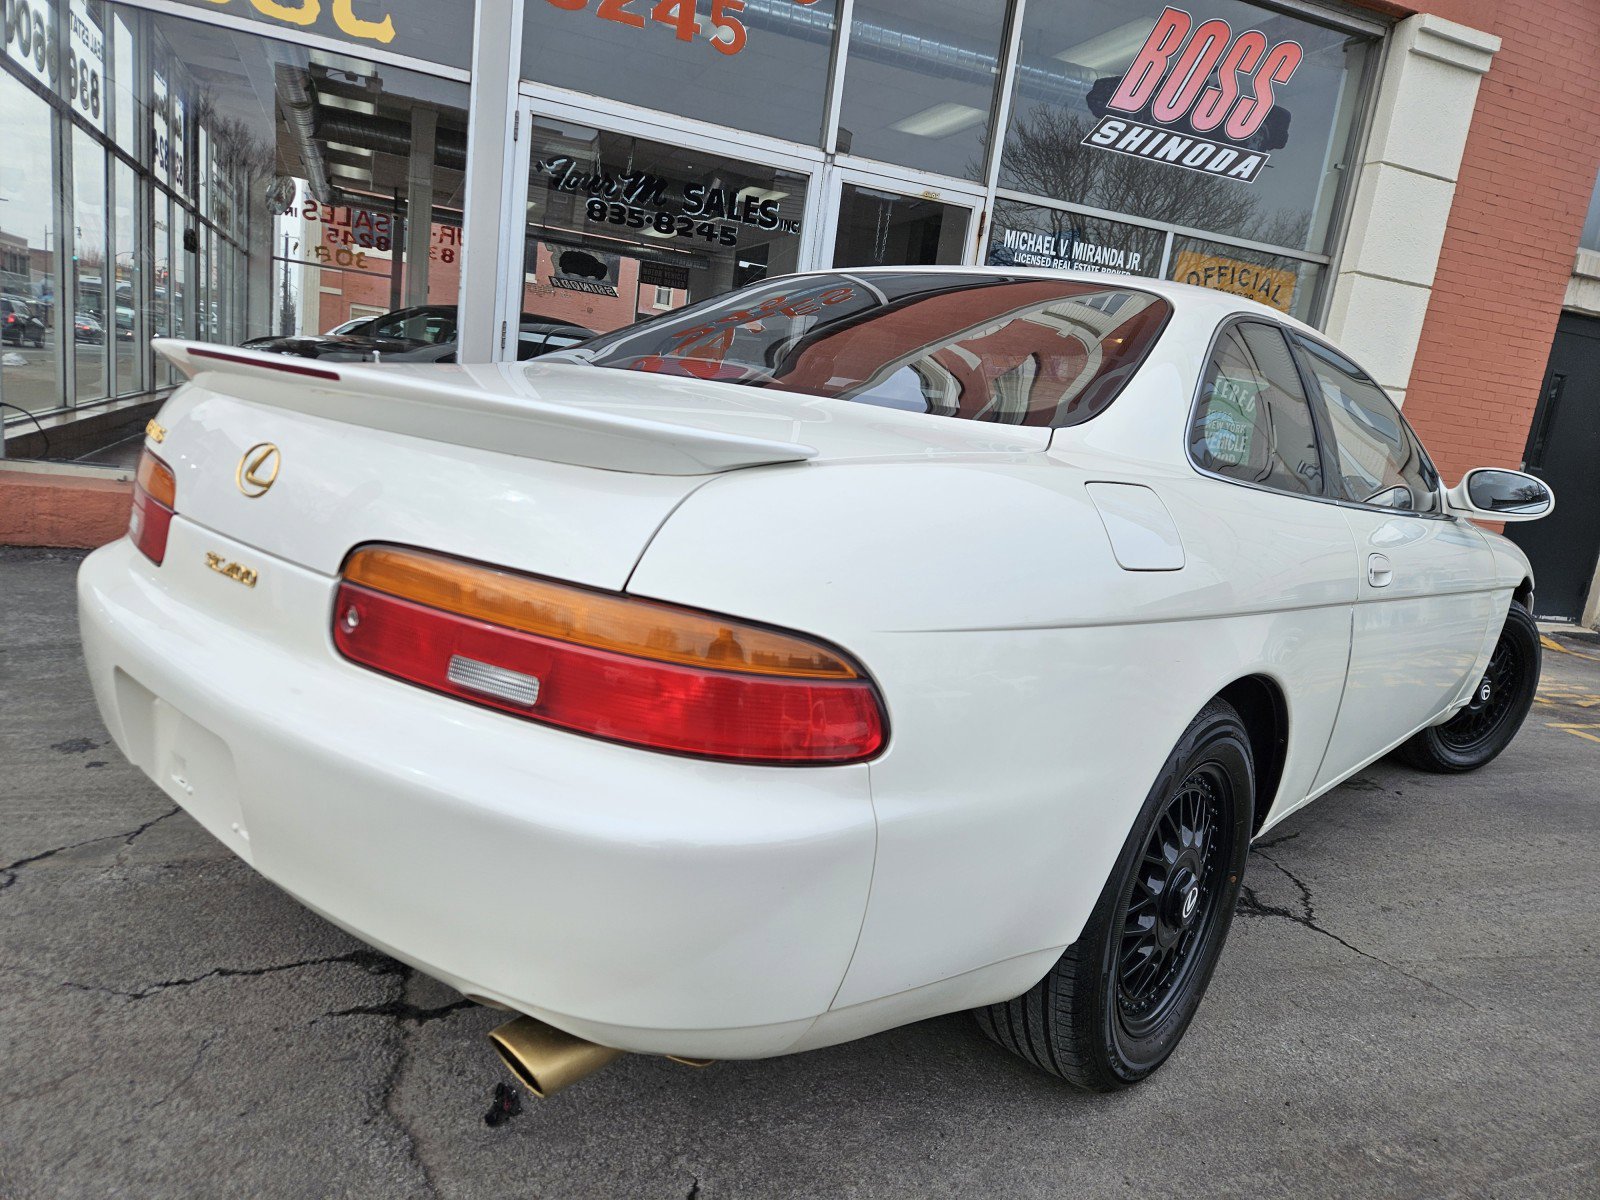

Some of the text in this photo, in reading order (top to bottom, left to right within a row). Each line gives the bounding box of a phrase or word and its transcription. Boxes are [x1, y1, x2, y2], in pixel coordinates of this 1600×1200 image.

[544, 0, 748, 56] 245
[1107, 6, 1303, 140] BOSS
[1090, 120, 1262, 179] SHINODA
[682, 182, 780, 231] SALES
[1003, 229, 1142, 272] MICHAEL V. MIRANDA JR.
[1014, 252, 1051, 268] LICENSED
[1052, 258, 1071, 270] REAL
[1073, 261, 1100, 273] ESTATE
[1186, 265, 1282, 306] OFFICIAL
[1225, 421, 1248, 435] YORK
